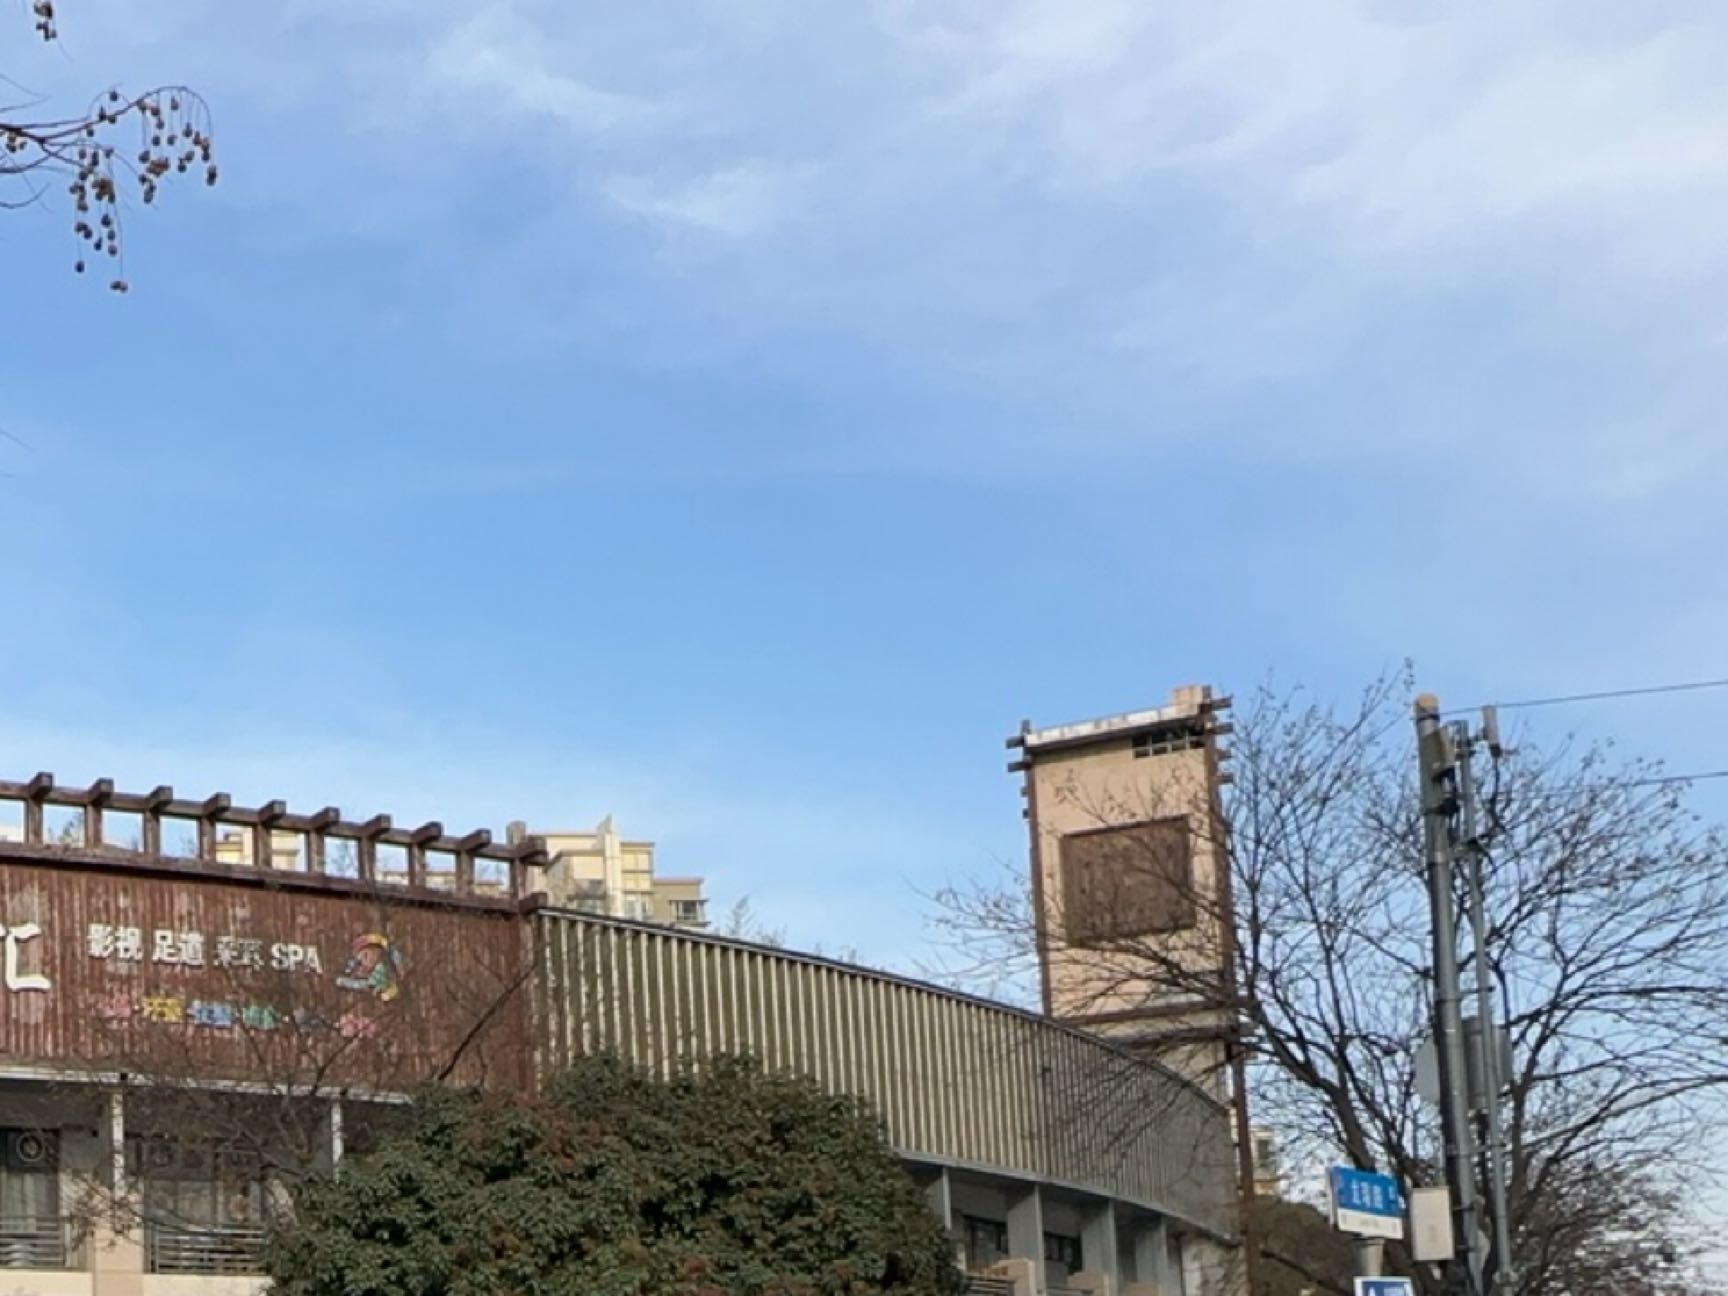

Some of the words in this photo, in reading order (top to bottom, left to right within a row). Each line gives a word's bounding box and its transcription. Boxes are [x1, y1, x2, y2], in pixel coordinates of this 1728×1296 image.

[87, 923, 143, 959] 影视
[152, 929, 204, 966] 足道
[271, 942, 323, 974] SPA
